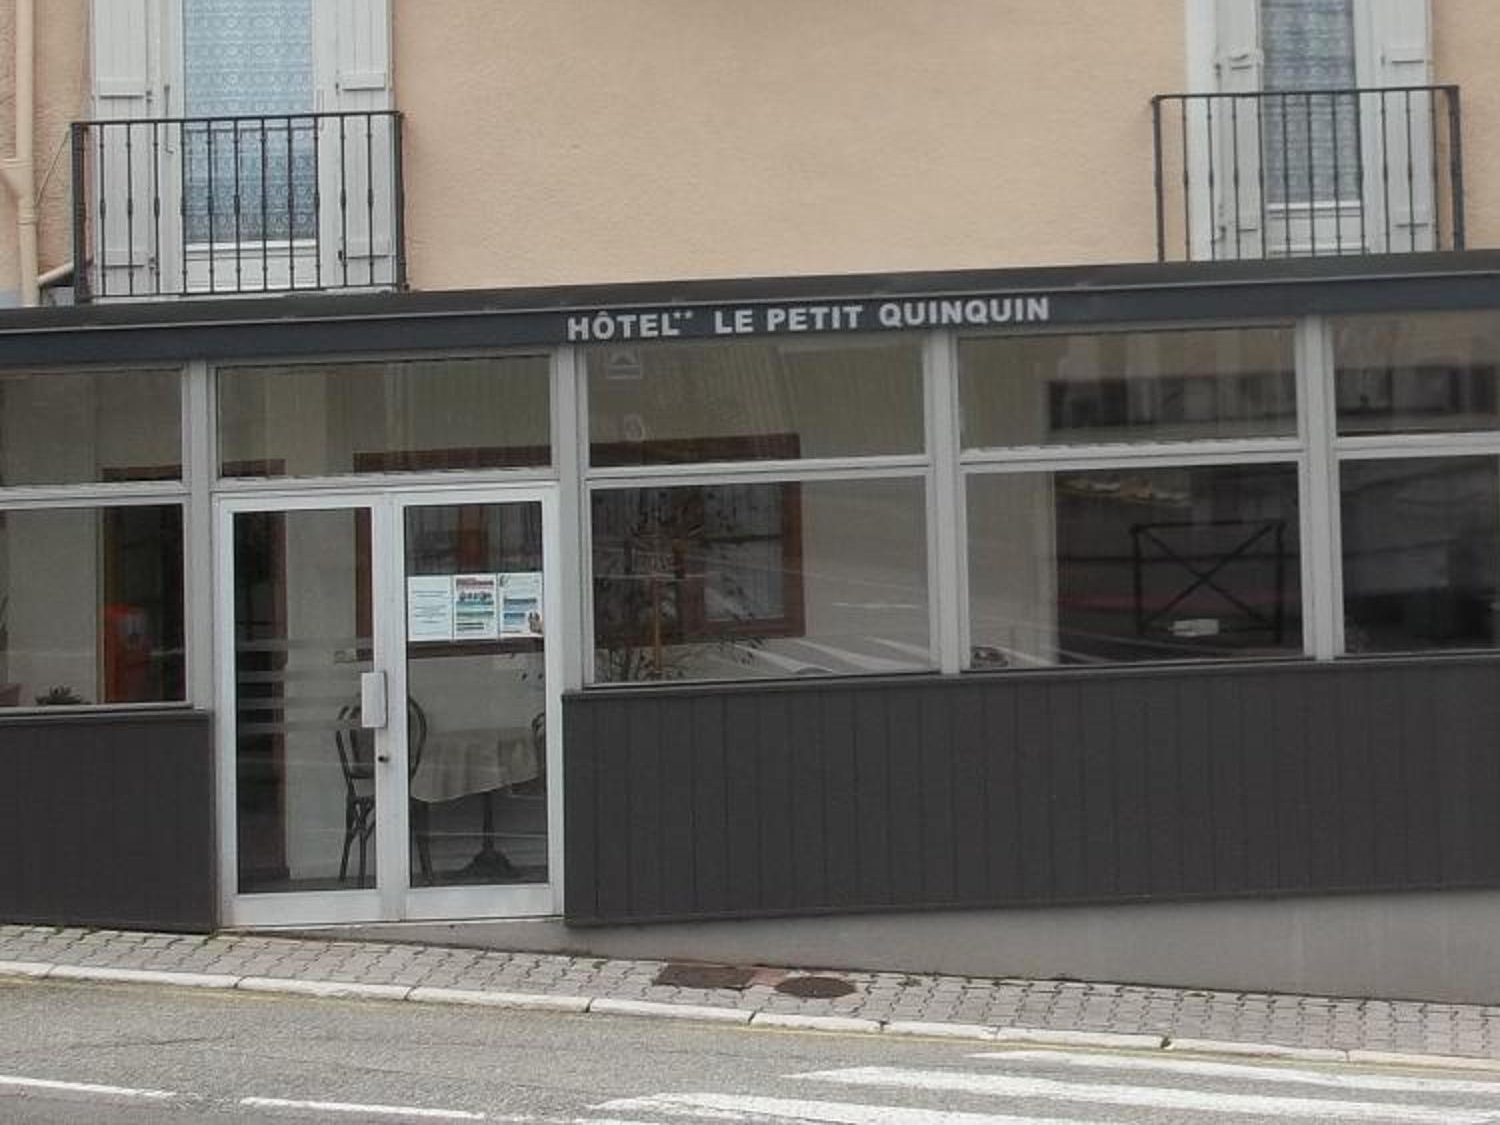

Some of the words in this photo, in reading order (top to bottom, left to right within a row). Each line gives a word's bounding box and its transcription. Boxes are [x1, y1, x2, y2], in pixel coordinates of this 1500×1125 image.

[714, 309, 754, 334] LE
[766, 304, 863, 332] PETIT
[879, 297, 1049, 327] QUINQUIN
